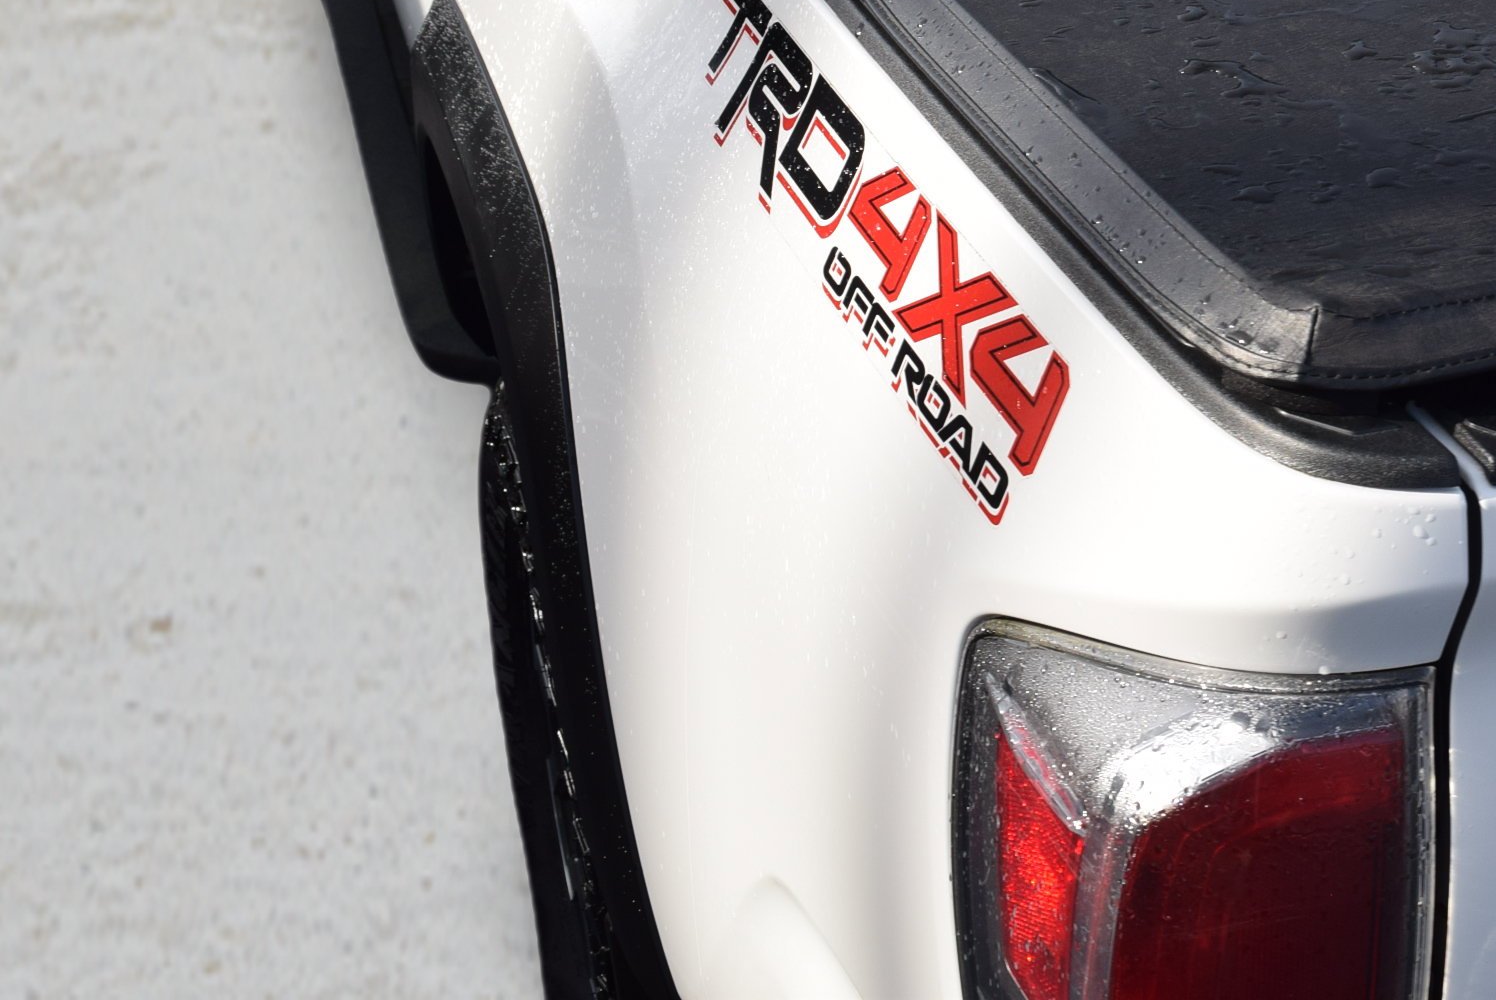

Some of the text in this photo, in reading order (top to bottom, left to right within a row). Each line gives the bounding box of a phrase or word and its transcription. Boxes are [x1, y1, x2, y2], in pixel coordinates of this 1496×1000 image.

[822, 246, 1010, 526] OFF ROAD
[847, 165, 1071, 476] 4X4
